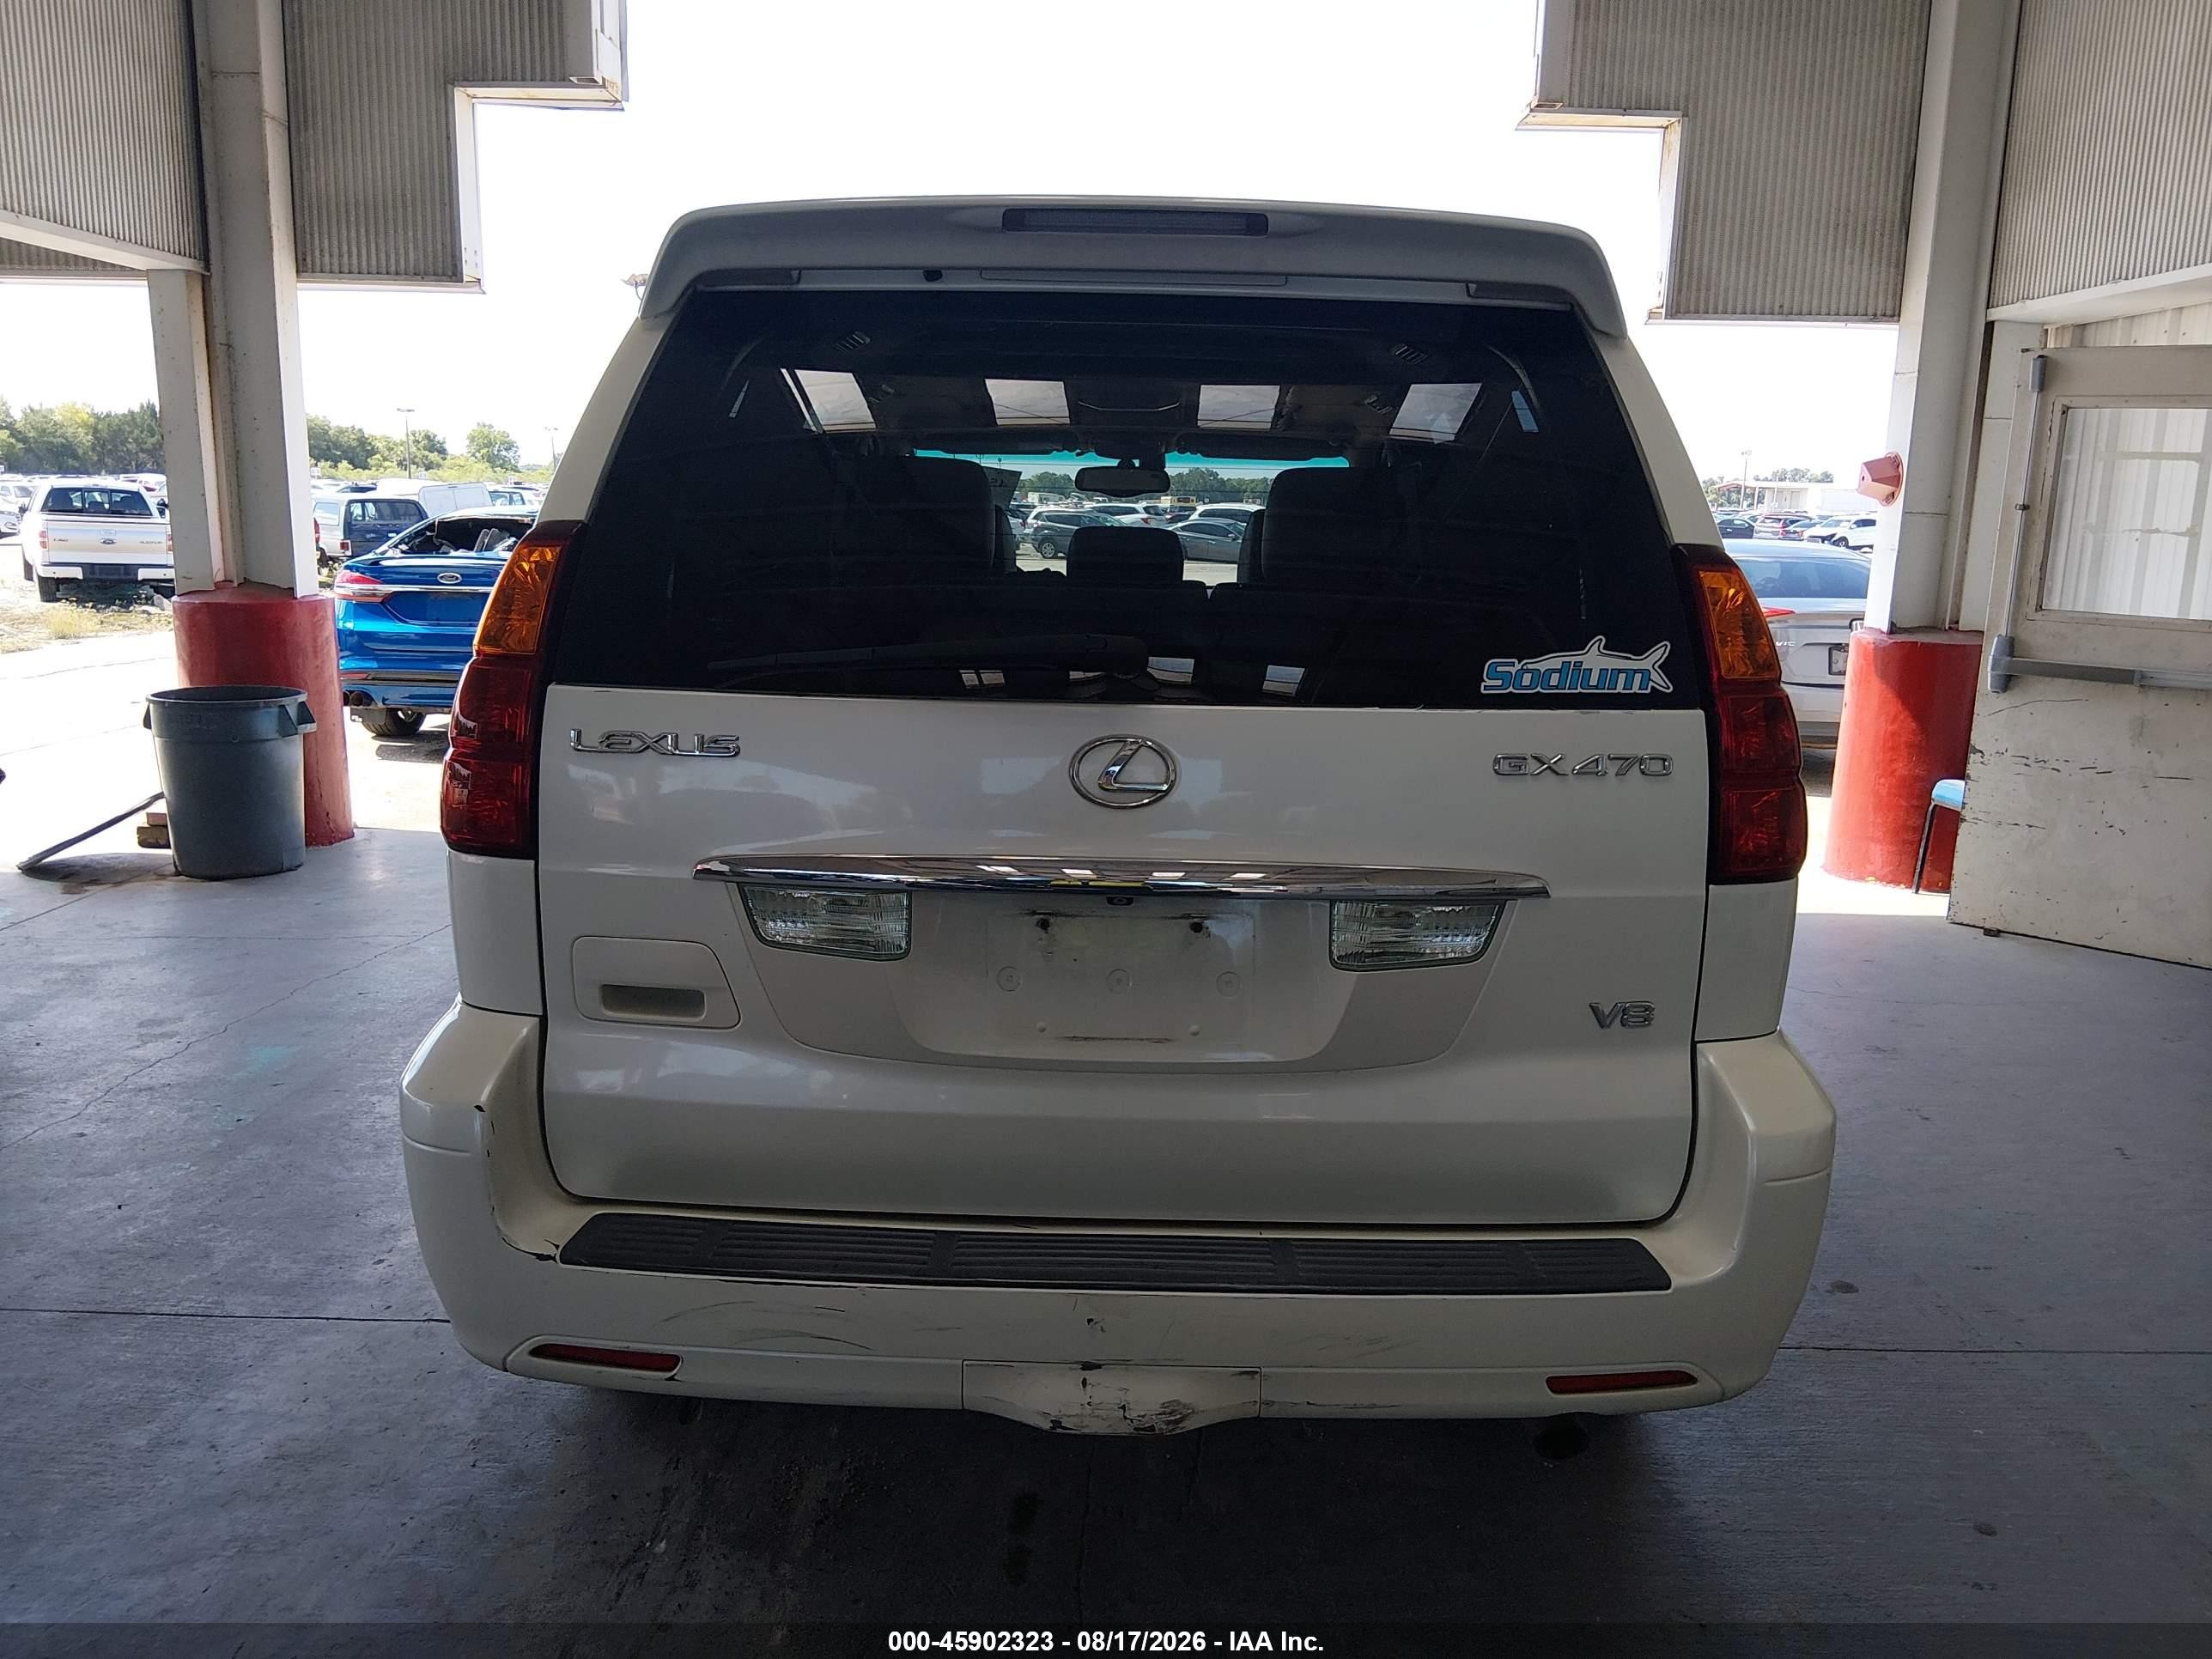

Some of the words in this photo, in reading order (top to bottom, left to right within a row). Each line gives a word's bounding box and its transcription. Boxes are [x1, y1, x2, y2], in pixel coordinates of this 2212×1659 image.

[1482, 659, 1653, 692] Sodium
[569, 728, 742, 757] LEXUS
[1589, 1000, 1656, 1030] V8
